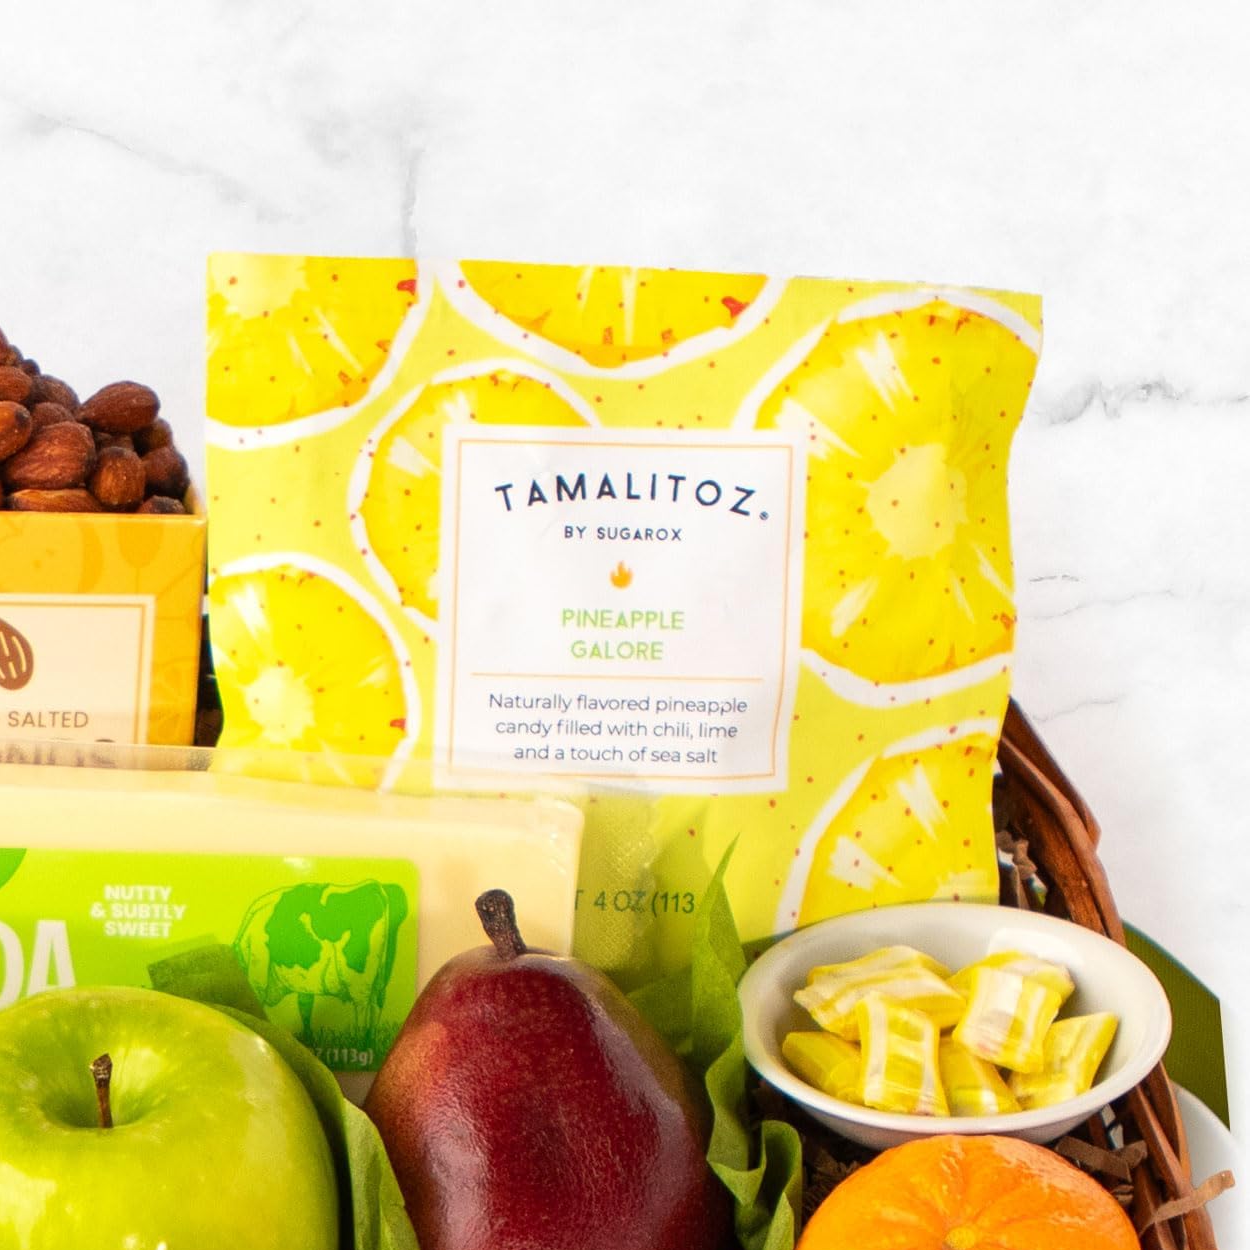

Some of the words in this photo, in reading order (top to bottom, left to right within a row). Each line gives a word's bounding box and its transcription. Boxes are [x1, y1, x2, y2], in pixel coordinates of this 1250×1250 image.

[564, 525, 586, 539] BY
[596, 526, 682, 541] SUGAROX
[561, 608, 684, 630] PINEAPPLE
[570, 640, 664, 660] GALORE
[488, 693, 573, 714] Naturally
[576, 694, 650, 713] flavored
[655, 697, 748, 717] pineapple
[7, 709, 89, 728] SALTED
[495, 719, 552, 738] candy
[556, 719, 602, 736] filled
[606, 720, 648, 738] with
[652, 720, 694, 740] chili,
[698, 721, 738, 739] lime
[513, 744, 549, 761] and
[554, 749, 565, 761] a
[570, 745, 623, 762] touch
[628, 746, 648, 763] of
[650, 751, 681, 764] sea
[686, 747, 718, 764] salt
[103, 884, 173, 902] NUTTY
[89, 902, 107, 920] &
[110, 903, 187, 921] SUBTLY
[593, 891, 607, 911] 4
[651, 891, 695, 917] (113
[104, 920, 173, 939] SWEET
[327, 1047, 374, 1066] (113g)
